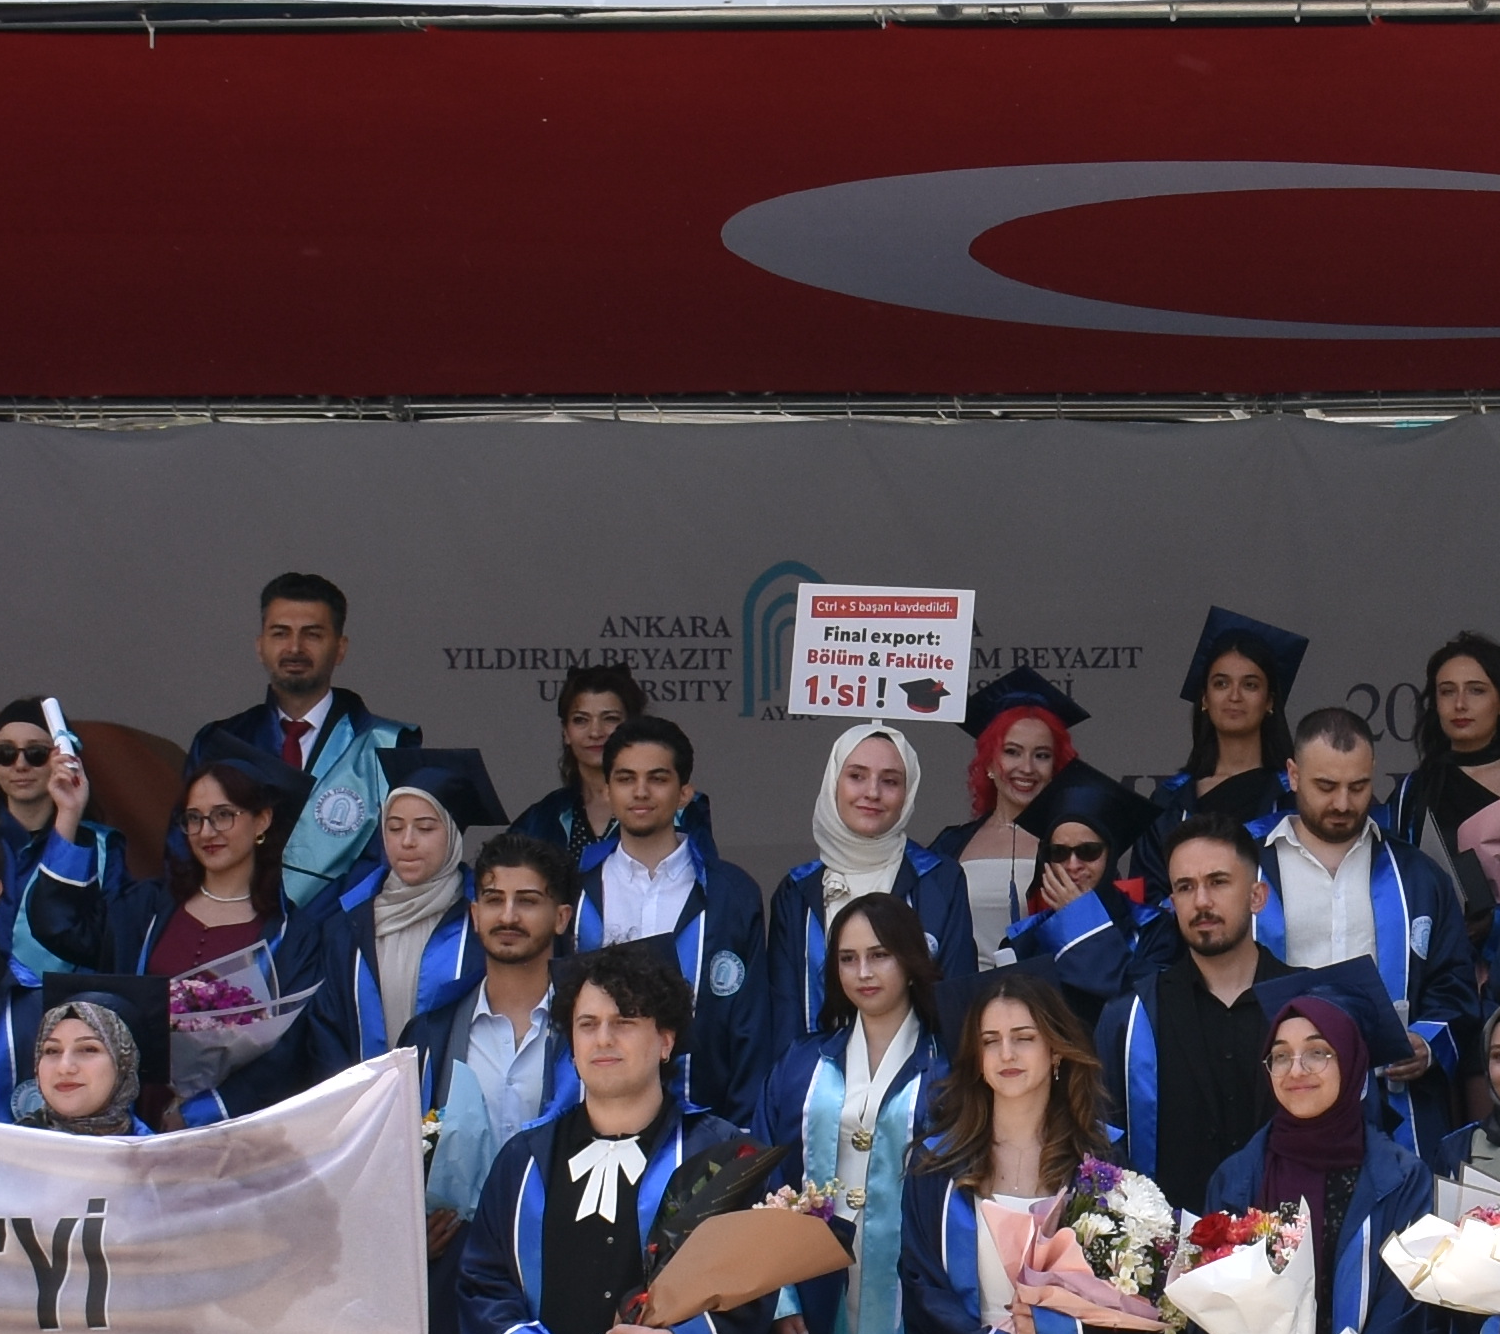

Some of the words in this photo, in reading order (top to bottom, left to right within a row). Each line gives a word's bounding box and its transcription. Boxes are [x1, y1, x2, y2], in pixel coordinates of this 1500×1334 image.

[816, 600, 837, 613] Ctrl
[840, 604, 847, 612] +
[849, 601, 856, 612] S
[599, 615, 732, 639] ANKARA
[823, 625, 867, 643] Final
[870, 630, 941, 648] export:
[442, 648, 588, 670] YILDIRIM
[601, 648, 733, 670] BEYAZIT
[807, 648, 864, 667] Bölüm
[868, 651, 881, 668] &
[886, 652, 954, 671] Fakülte
[875, 677, 888, 709] !
